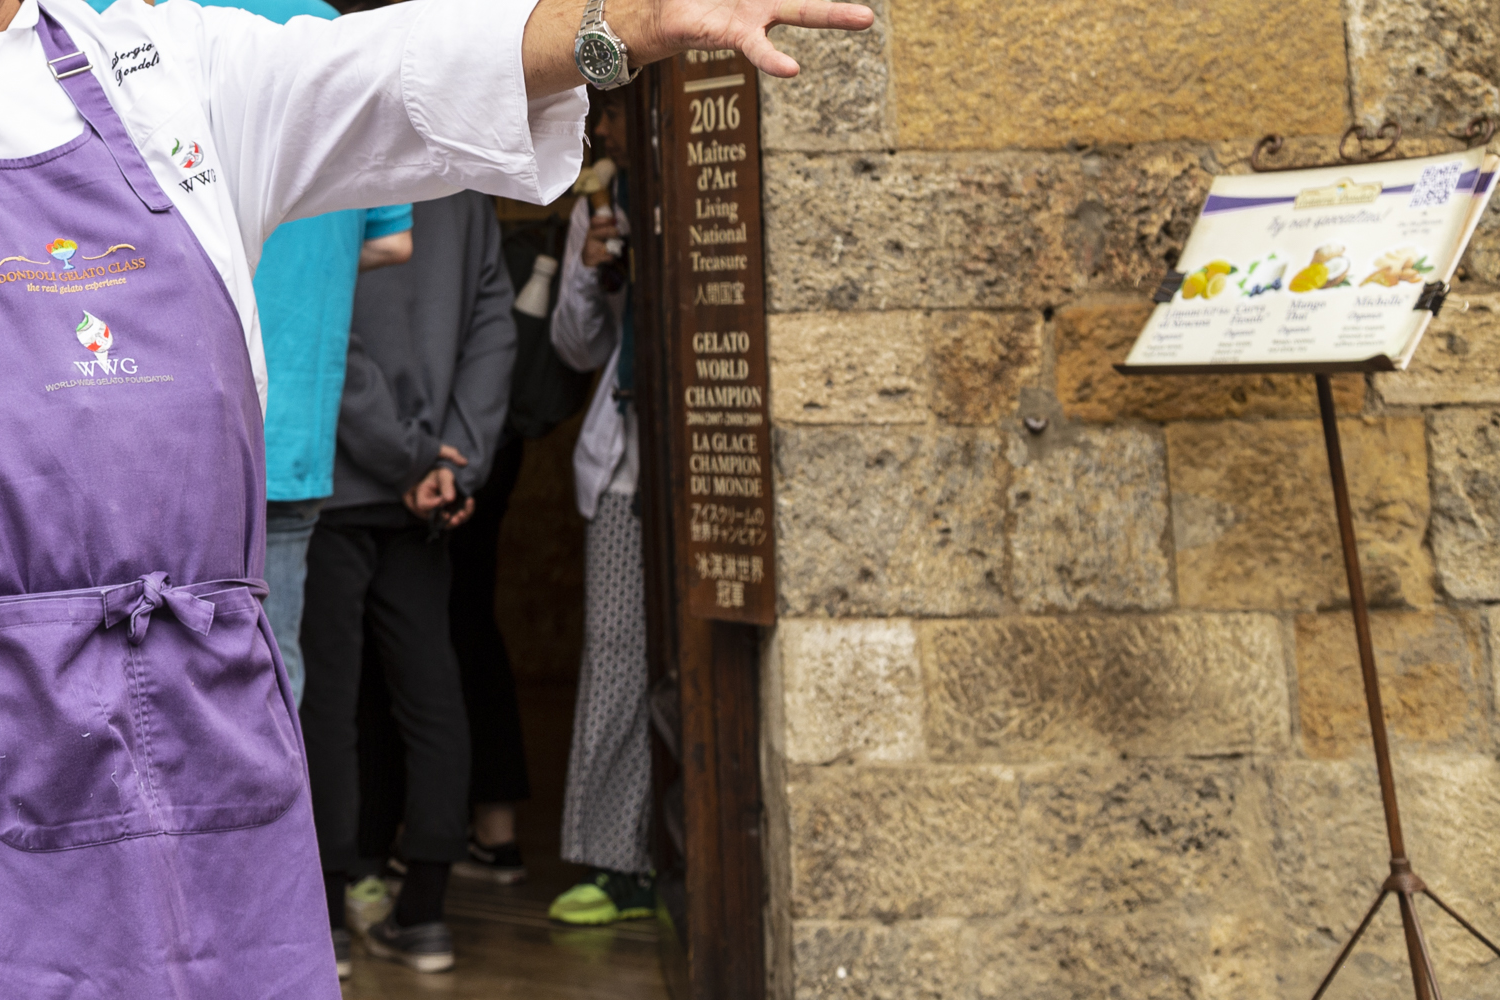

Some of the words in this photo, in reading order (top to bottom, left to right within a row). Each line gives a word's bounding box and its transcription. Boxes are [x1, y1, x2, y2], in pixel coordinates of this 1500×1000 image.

[112, 43, 154, 70] Sergio
[689, 93, 740, 134] 2016
[687, 139, 746, 166] Maîtres
[179, 168, 216, 194] WWG
[697, 166, 737, 191] d'Art
[695, 196, 739, 224] Living
[689, 222, 747, 246] National
[58, 266, 106, 282] GELATO
[108, 257, 146, 274] CLASS
[689, 251, 747, 272] Treasure
[27, 283, 40, 292] the
[42, 284, 58, 293] real
[59, 283, 83, 295] gelato
[85, 277, 127, 292] experience
[692, 331, 750, 354] GELATO
[74, 358, 139, 377] WWG
[126, 374, 174, 384] FOUNDATION
[695, 358, 749, 380] WORLD
[685, 385, 762, 408] CHAMPION
[692, 431, 710, 452] LA
[711, 432, 758, 454] GLACE
[689, 453, 761, 476] CHAMPION
[690, 475, 711, 496] DU
[713, 475, 764, 498] MONDE
